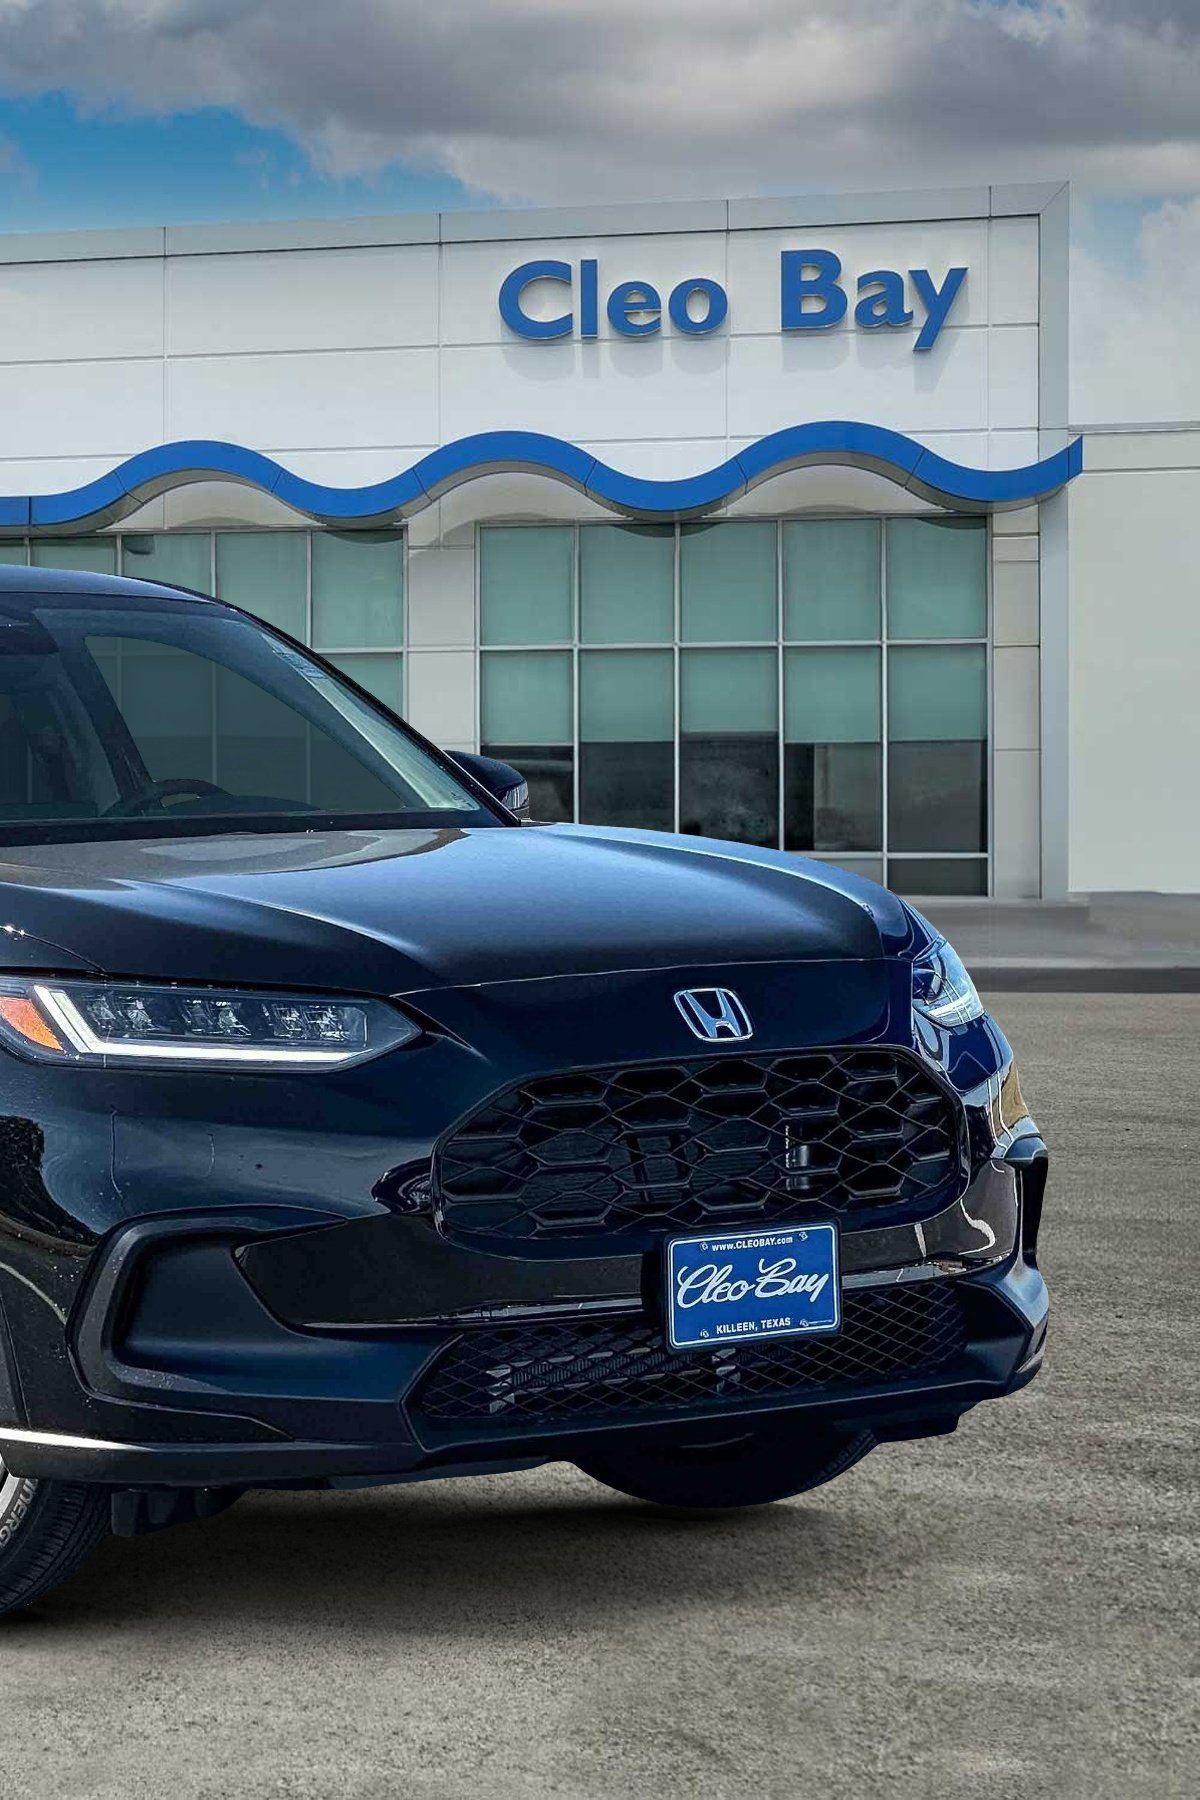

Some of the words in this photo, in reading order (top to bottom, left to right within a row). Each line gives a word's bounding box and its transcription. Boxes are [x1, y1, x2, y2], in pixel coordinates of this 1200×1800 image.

[499, 259, 728, 339] Cleo
[781, 249, 968, 351] Bay
[711, 1236, 793, 1252] www.CLEOBAY.com
[677, 1264, 755, 1309] Cleo
[754, 1258, 830, 1303] Bay
[716, 1321, 758, 1335] KILLEEN,
[760, 1317, 791, 1330] TEXAS
